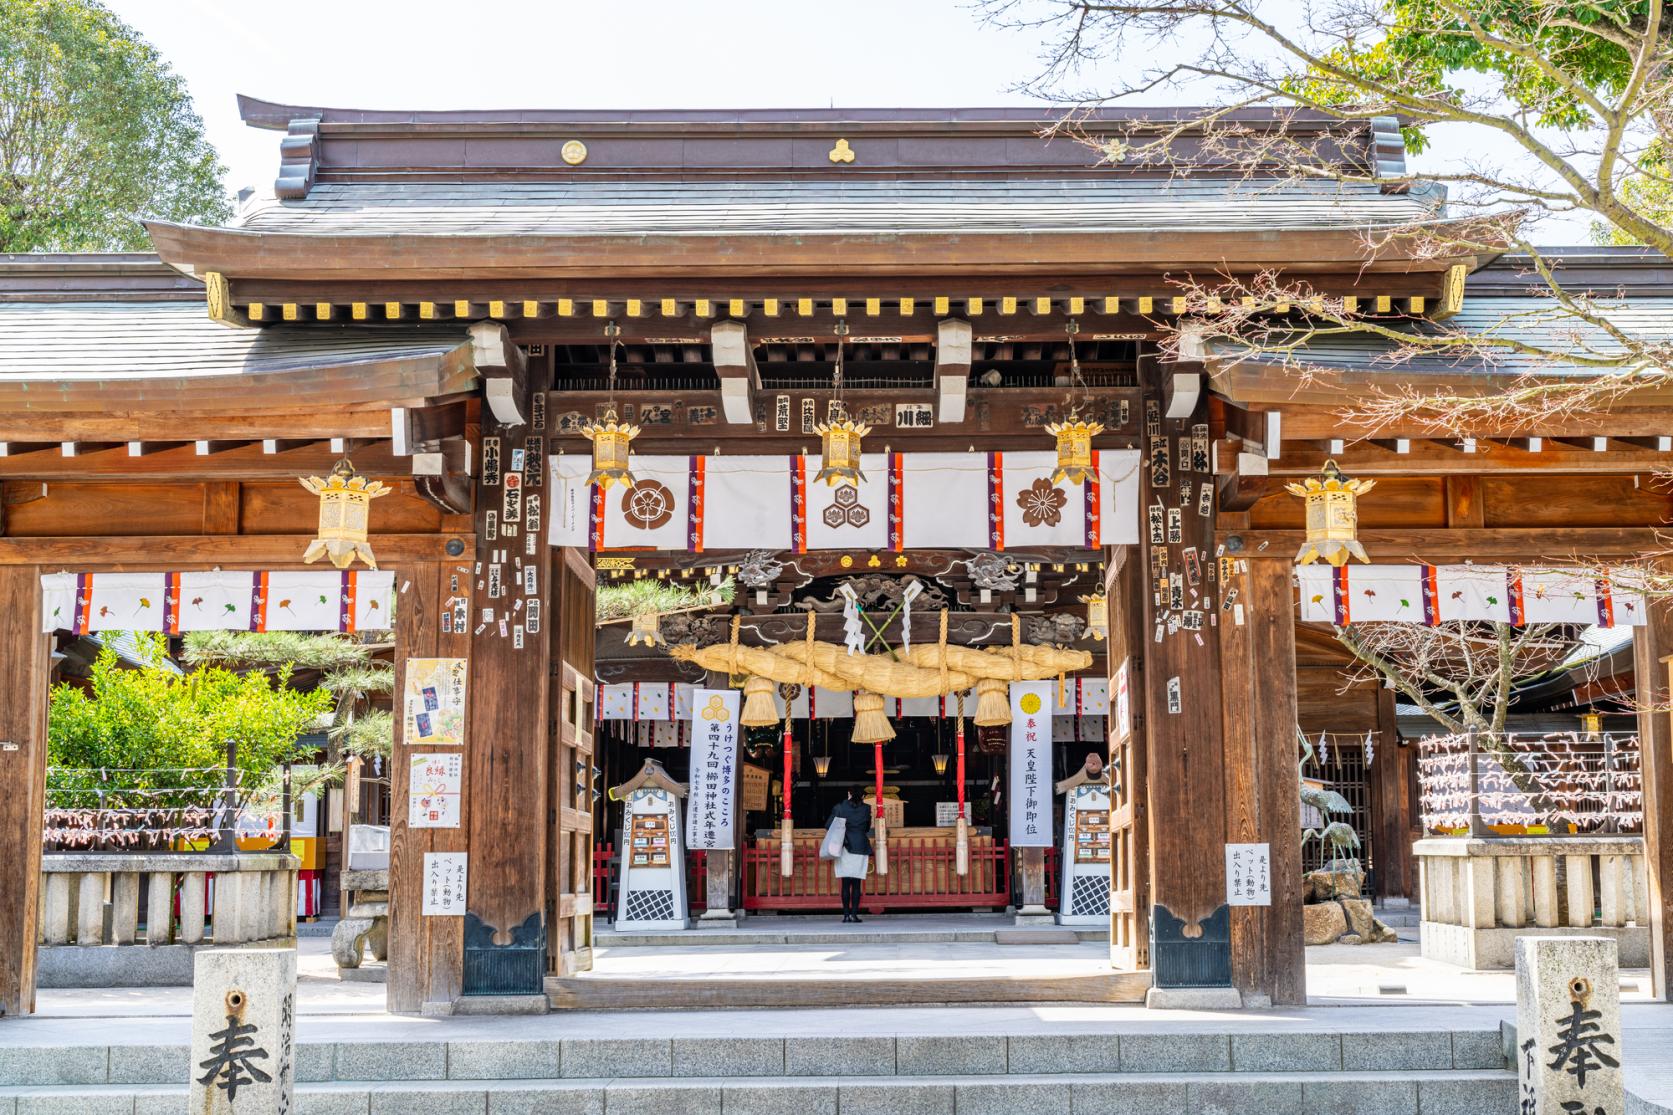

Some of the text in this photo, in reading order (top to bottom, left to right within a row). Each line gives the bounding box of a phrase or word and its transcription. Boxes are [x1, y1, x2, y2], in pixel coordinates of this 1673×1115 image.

[721, 723, 733, 827] うけつぐ博多のこころ
[1025, 718, 1038, 835] 奉祝 天皇陛下御即位
[430, 860, 439, 906] 出入り禁止
[456, 865, 464, 902] 是より先
[1233, 850, 1242, 896] 出入り禁止
[1260, 855, 1269, 892] 是より先
[196, 1015, 273, 1103] 奉
